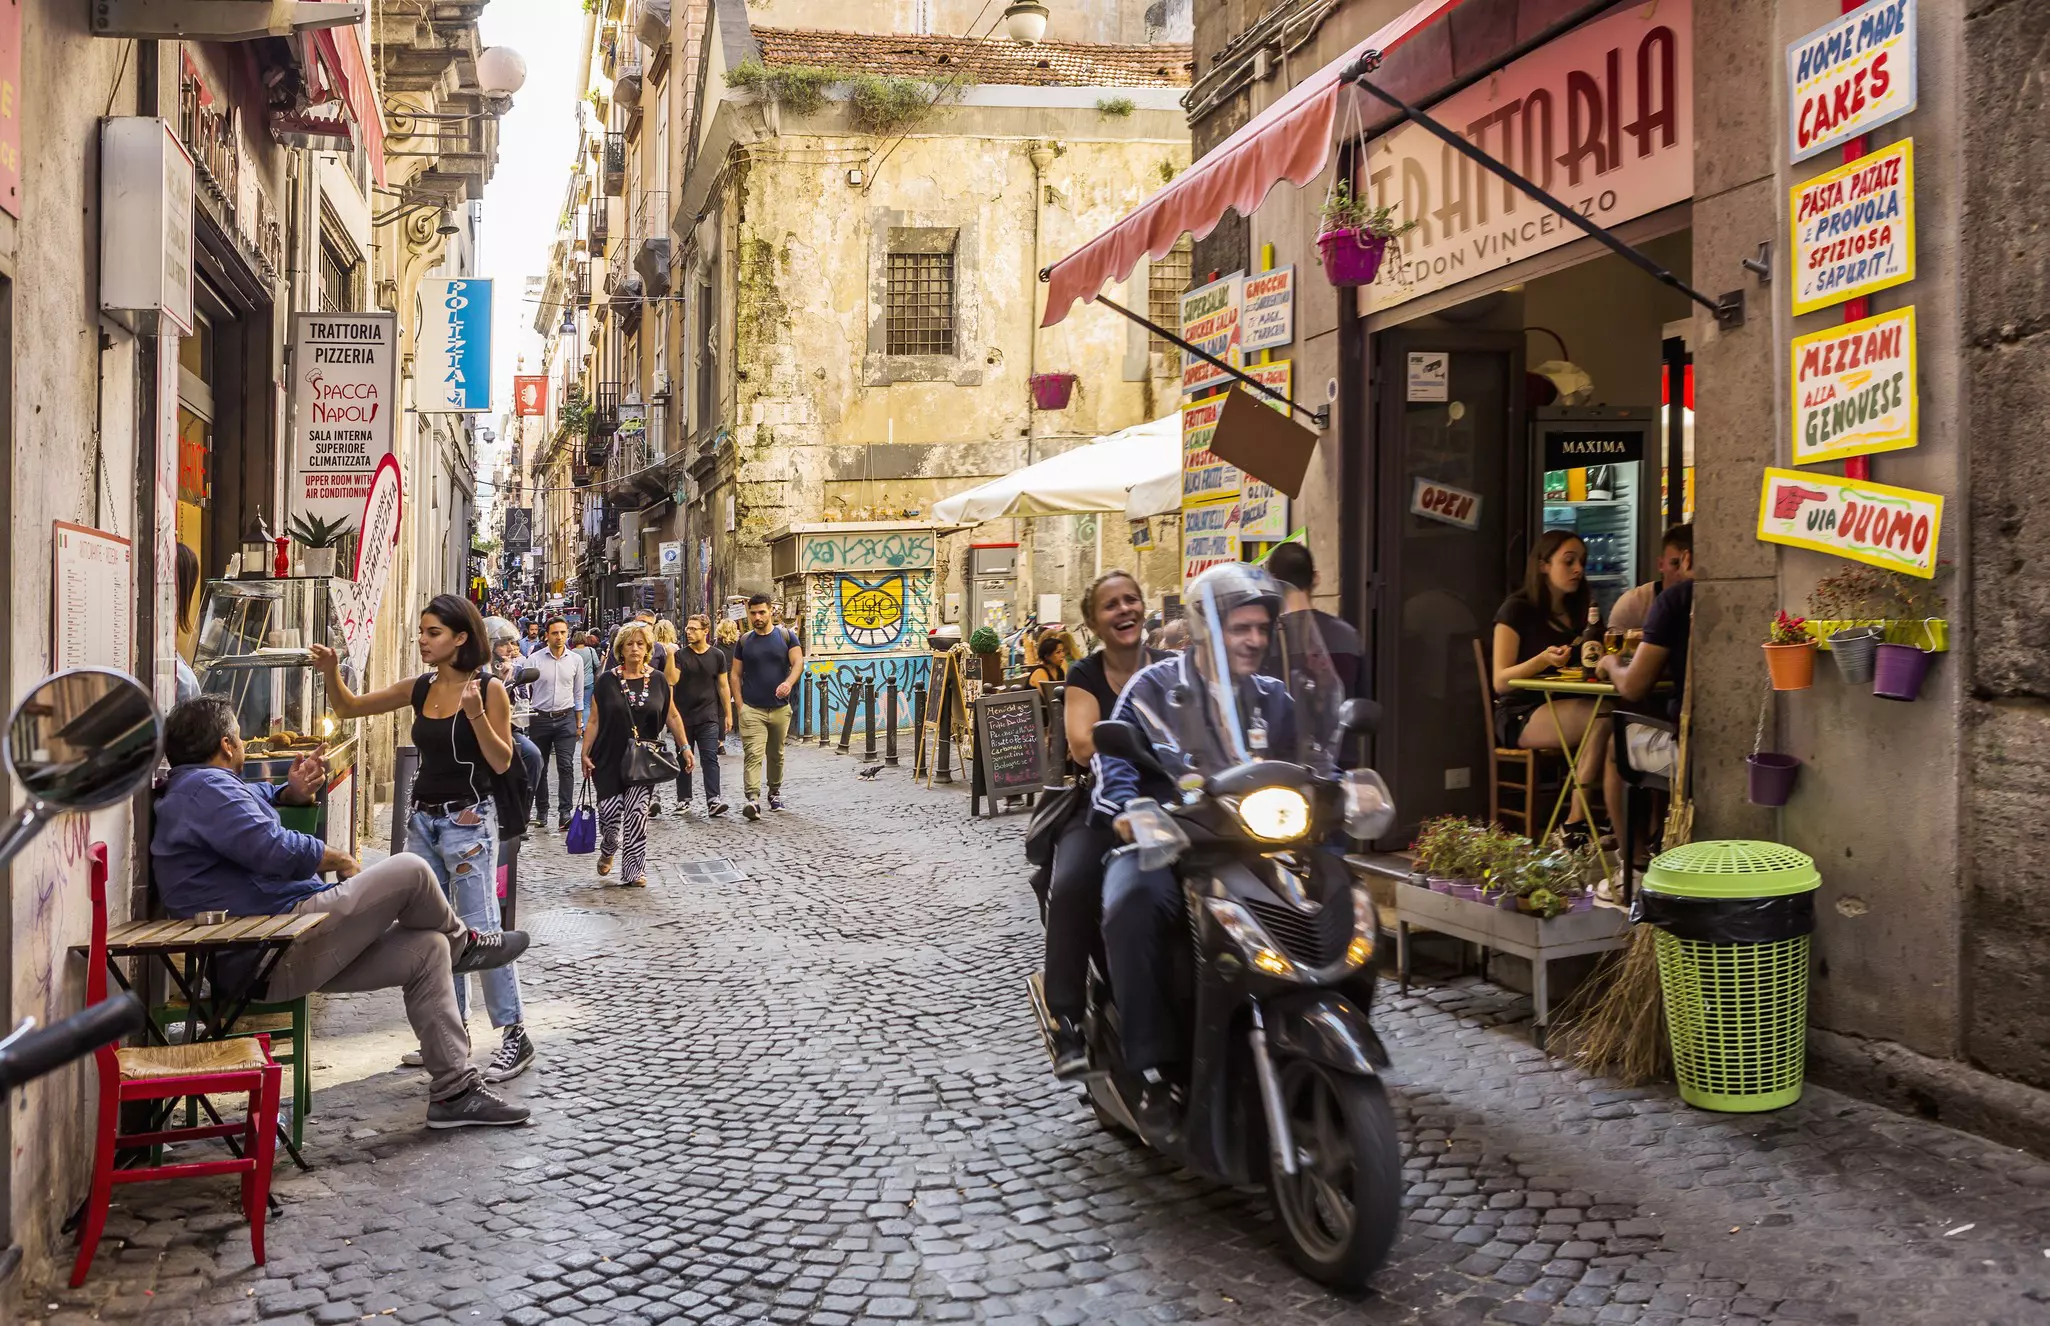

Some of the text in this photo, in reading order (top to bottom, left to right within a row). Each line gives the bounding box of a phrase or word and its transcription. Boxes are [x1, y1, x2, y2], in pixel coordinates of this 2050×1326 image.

[1797, 0, 1907, 83] HOME MADE
[1798, 51, 1890, 149] CAKES
[1371, 25, 1677, 257] TRATTORIA
[1798, 157, 1901, 222] PASTA PATATE
[1809, 225, 1891, 269] SFIZIOSA
[1415, 248, 1464, 283] DON
[310, 323, 382, 339] TRATTORIA
[315, 348, 375, 363] PIZZERIA
[1799, 325, 1902, 382] MEZZANI
[312, 376, 378, 400] SPACCA
[1803, 383, 1837, 409] ALLA
[1805, 371, 1903, 447] GENOVESE
[309, 430, 373, 441] SALA INTERNA
[315, 443, 366, 454] SUPERIORE
[1562, 440, 1626, 454] MAXIMA
[309, 456, 371, 466] CLIMATIZZATA
[305, 474, 373, 486] UPPER ROOM WITH
[305, 489, 319, 498] AIR
[1422, 487, 1473, 520] OPEN
[1807, 502, 1929, 555] VIA DUOMO
